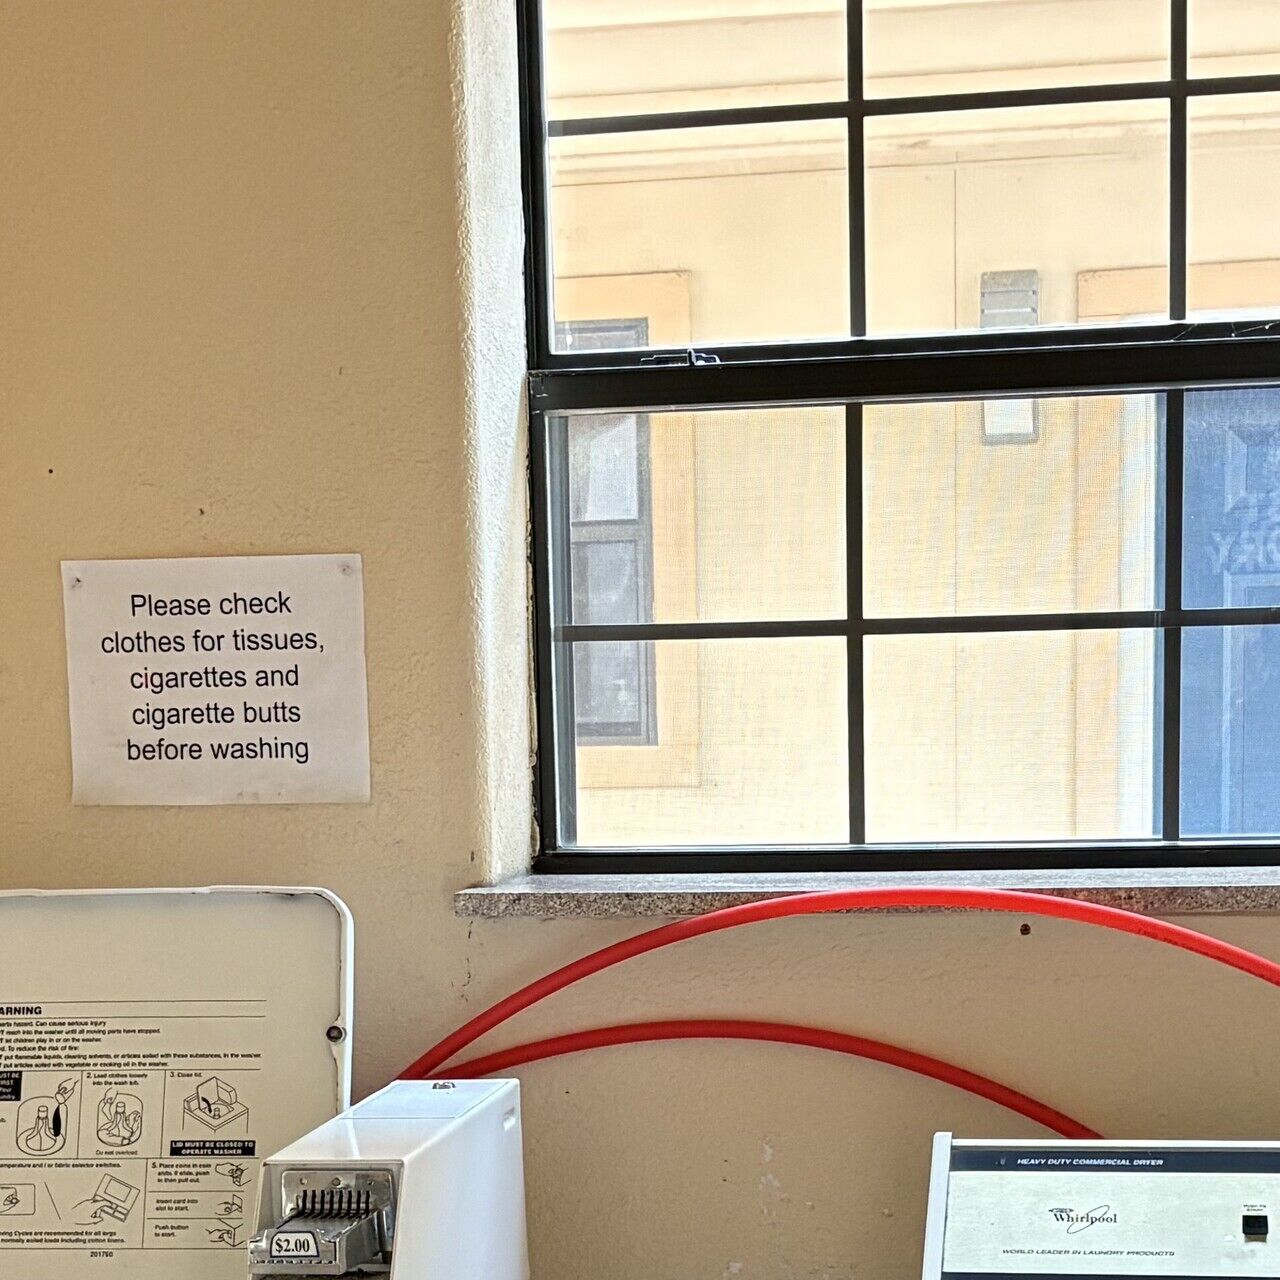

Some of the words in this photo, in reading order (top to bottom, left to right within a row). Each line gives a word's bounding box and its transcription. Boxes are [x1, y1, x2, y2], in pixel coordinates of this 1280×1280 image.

[130, 594, 211, 617] Please
[219, 591, 292, 615] check
[101, 631, 185, 654] clothes
[192, 630, 225, 652] for
[232, 629, 324, 654] tissues,
[130, 666, 247, 694] cigarettes
[255, 664, 299, 687] and
[132, 703, 235, 730] cigarette
[243, 701, 301, 723] butts
[127, 738, 203, 760] before
[210, 737, 309, 763] washing
[1053, 1213, 1117, 1225] Whirlpool
[275, 1236, 311, 1254] $2.00
